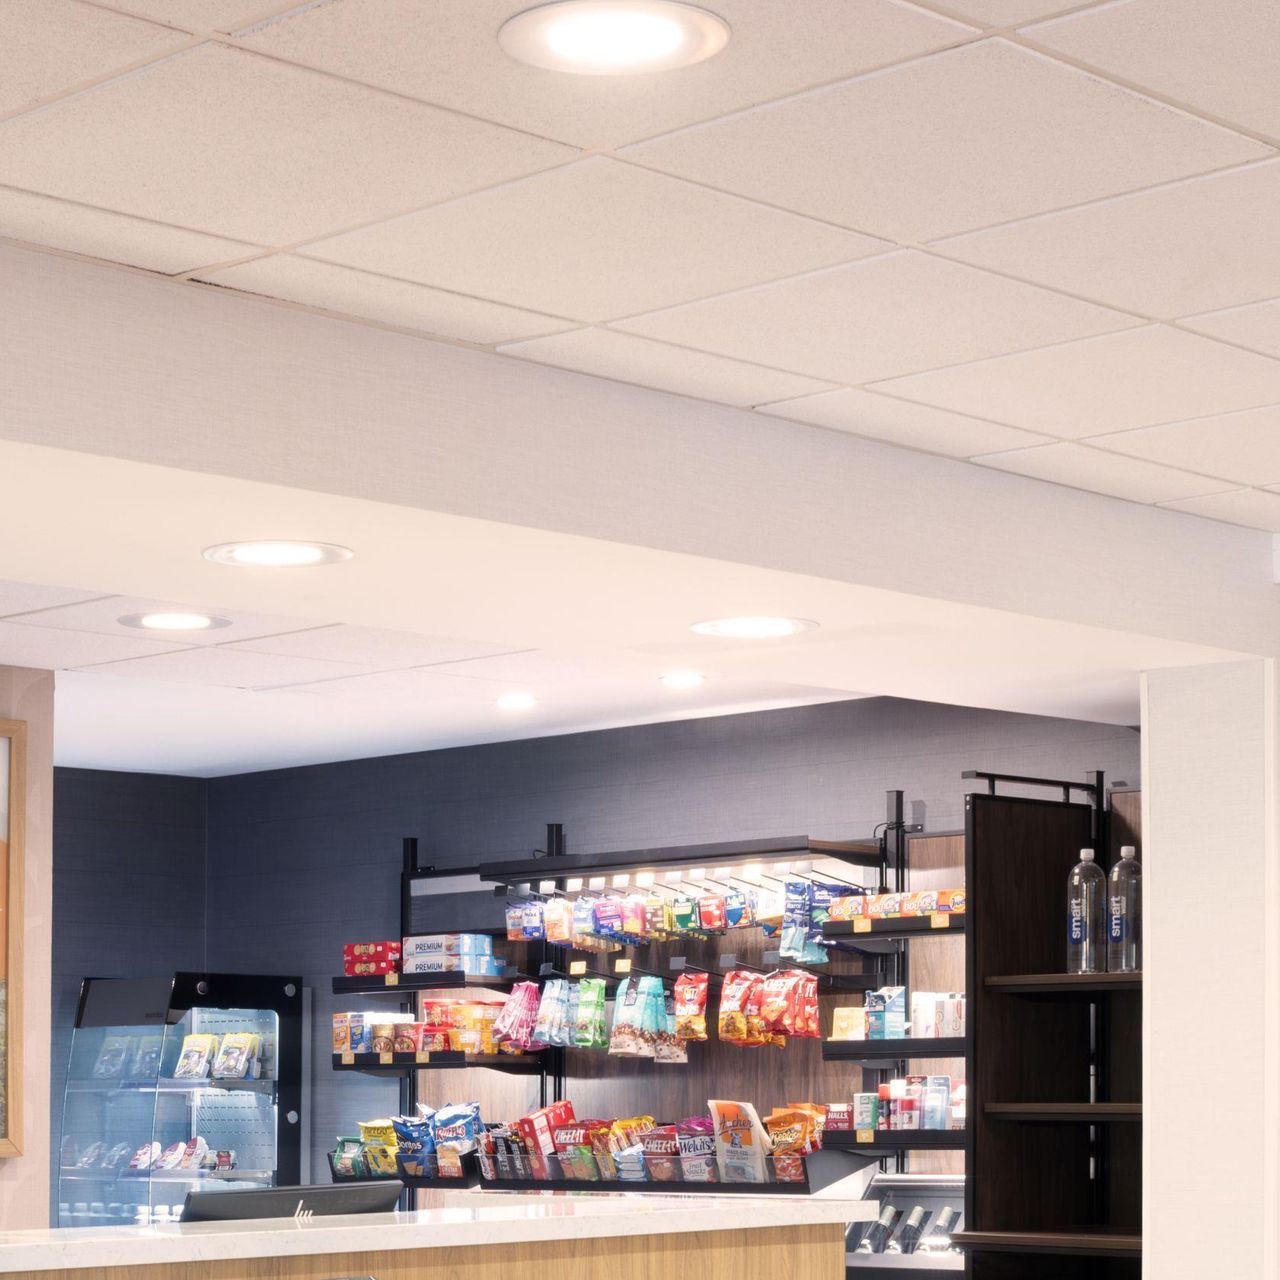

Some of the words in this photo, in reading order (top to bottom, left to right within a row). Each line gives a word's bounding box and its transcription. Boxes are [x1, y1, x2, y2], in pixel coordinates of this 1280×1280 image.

[1071, 898, 1081, 939] smart
[1111, 896, 1121, 937] smart
[415, 942, 443, 952] PREMIUM
[415, 962, 443, 972] PREMIUM
[645, 1139, 676, 1153] CHEEZ-IT
[679, 1138, 711, 1154] Welch's
